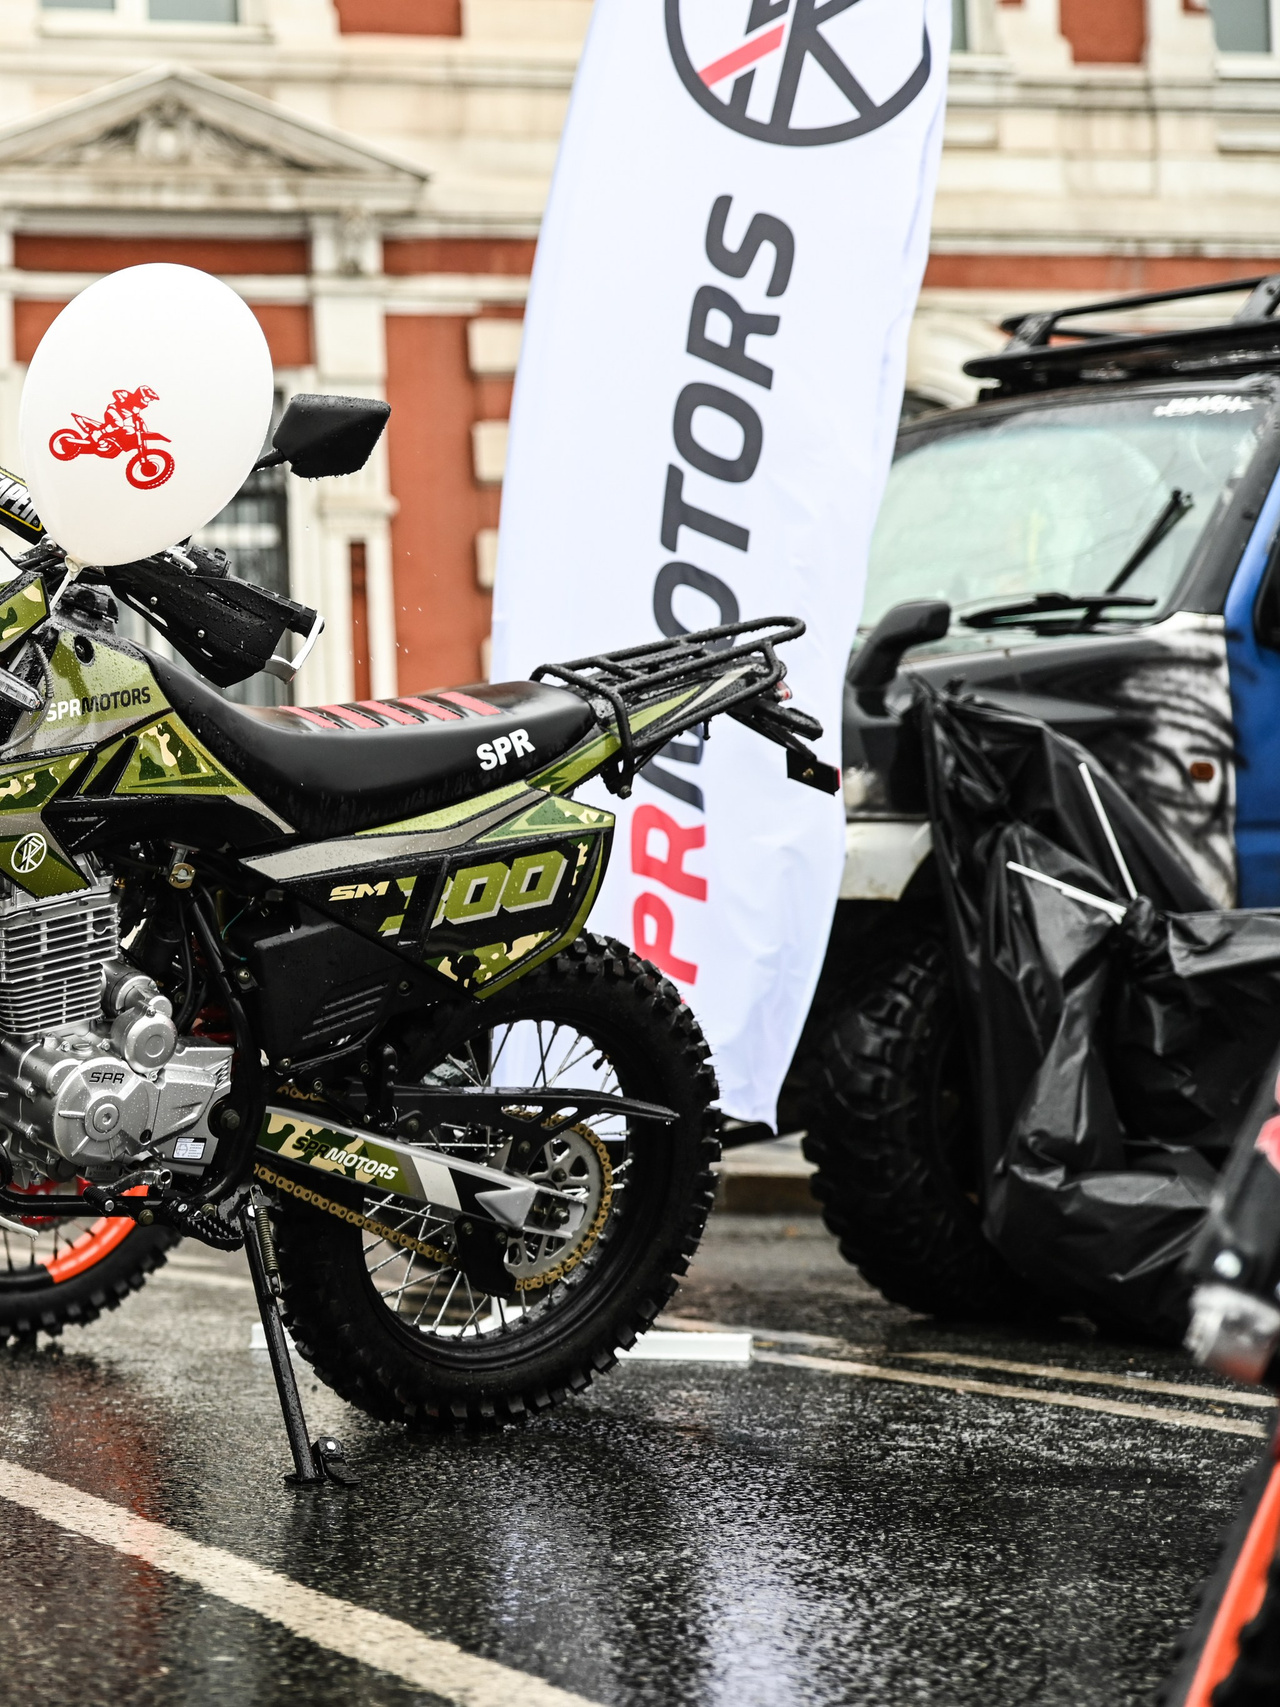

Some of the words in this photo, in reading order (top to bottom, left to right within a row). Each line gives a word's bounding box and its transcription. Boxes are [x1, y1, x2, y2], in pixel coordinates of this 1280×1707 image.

[46, 686, 151, 722] SPRMOTORS
[476, 729, 535, 770] SPR
[329, 881, 390, 901] SM
[89, 1072, 125, 1084] SPR
[292, 1136, 399, 1180] SPRMOTORS
